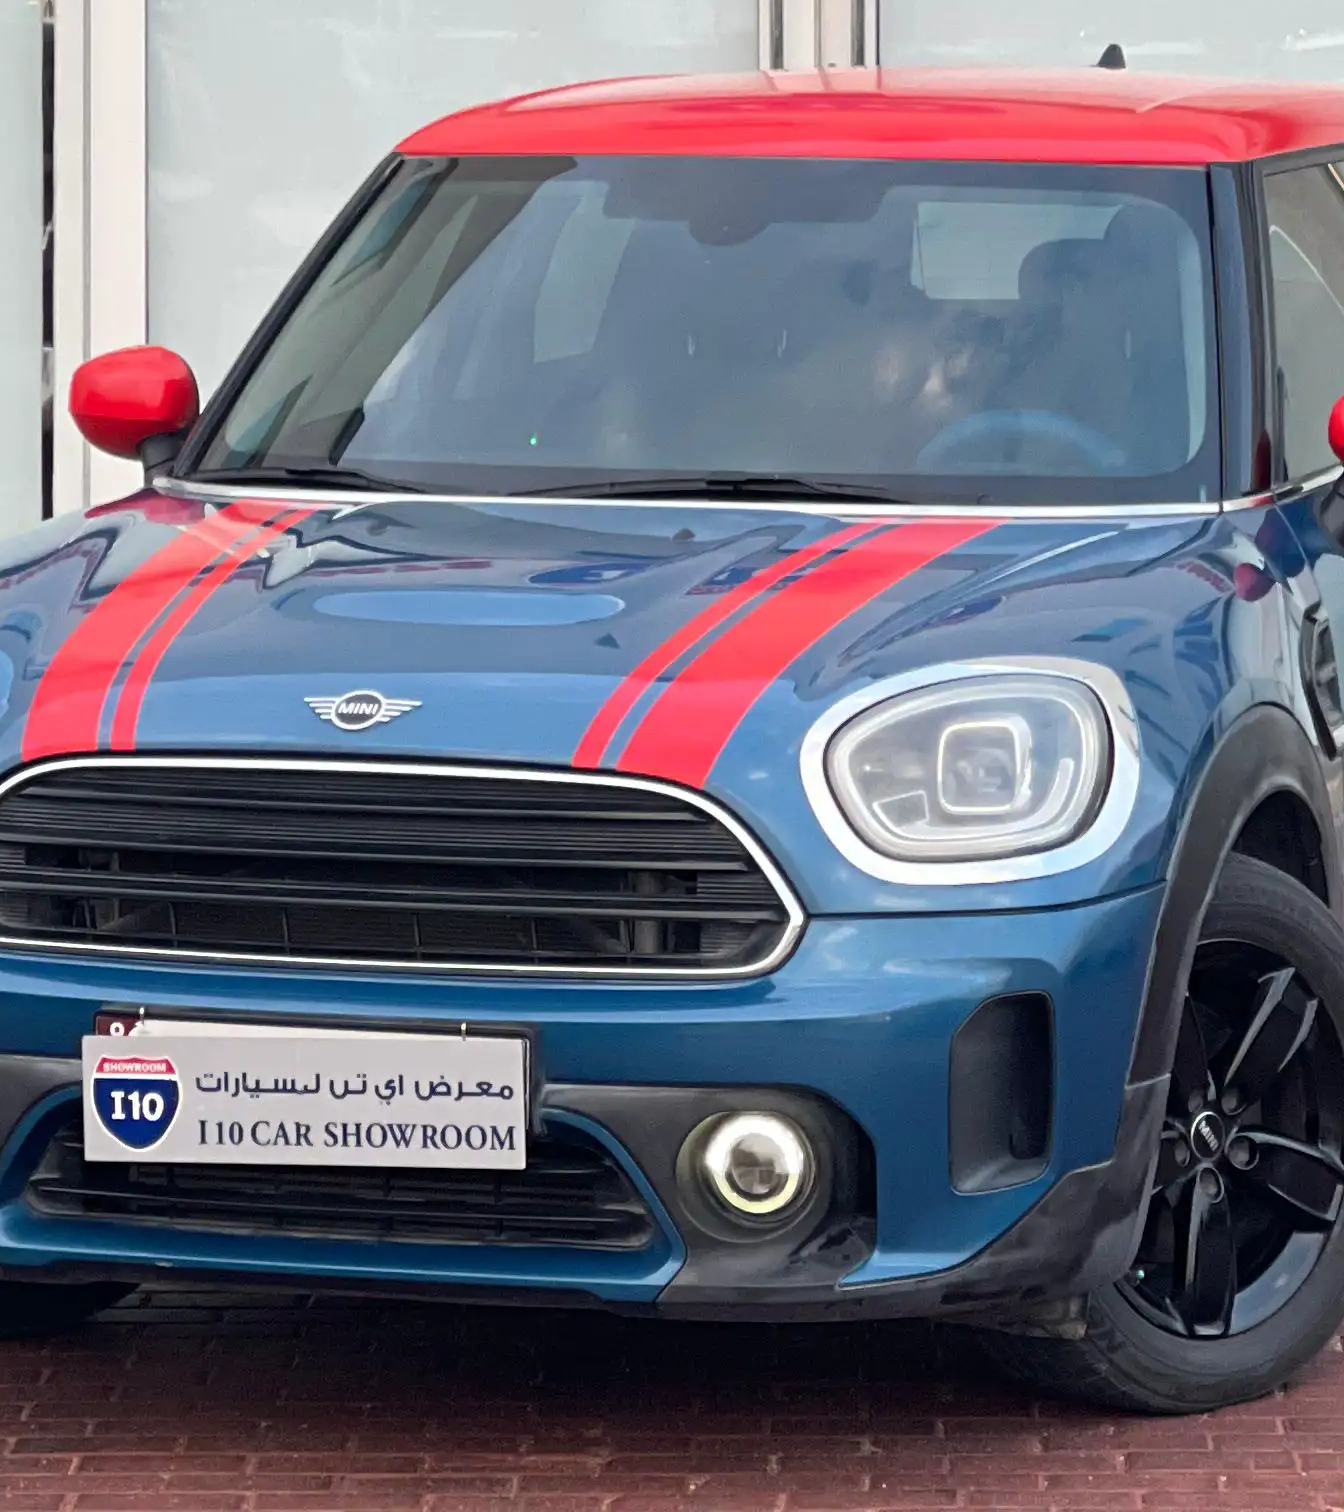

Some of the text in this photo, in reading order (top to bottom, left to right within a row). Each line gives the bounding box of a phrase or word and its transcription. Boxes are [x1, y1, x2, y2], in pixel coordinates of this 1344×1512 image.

[337, 701, 379, 715] MINI
[102, 1062, 167, 1073] SHOWROOM
[414, 1074, 514, 1101] معرض
[110, 1090, 165, 1122] I10
[250, 1120, 314, 1147] CAR
[323, 1122, 517, 1151] SHOWROOM
